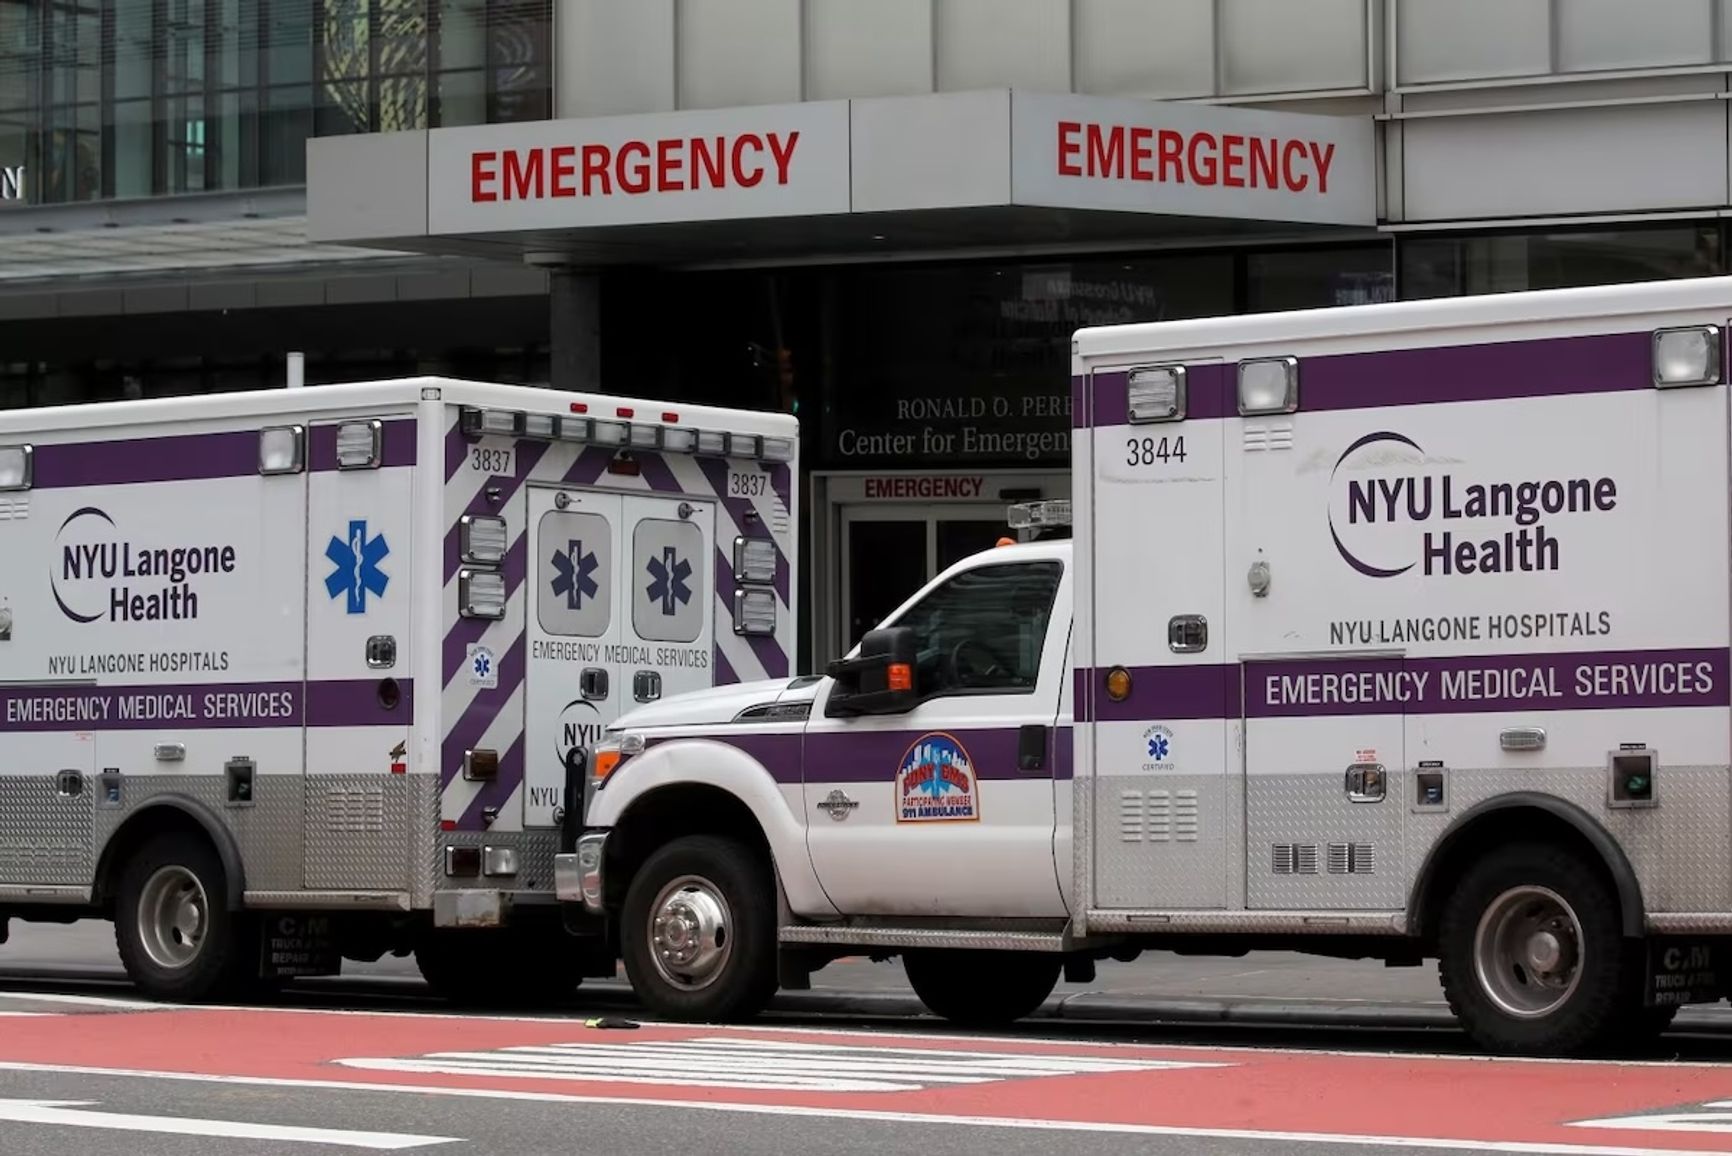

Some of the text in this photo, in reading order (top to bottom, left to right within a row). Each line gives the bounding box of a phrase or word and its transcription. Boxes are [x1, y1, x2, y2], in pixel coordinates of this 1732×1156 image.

[471, 132, 799, 202] EMERGENCY
[1058, 122, 1335, 194] EMERGENCY
[898, 397, 985, 419] RONALD
[992, 397, 1013, 418] O.
[839, 427, 1071, 459] Center for Emergen
[1127, 435, 1187, 467] 3844
[472, 448, 511, 473] 3837
[731, 472, 767, 496] 3837
[864, 477, 983, 498] EMERGENCY
[1348, 476, 1617, 525] NYU Langone
[63, 542, 235, 582] NYU Langone
[1424, 526, 1560, 576] Health
[110, 584, 198, 622] Health
[1329, 612, 1612, 645] NYU LANGONE HOSPITALS
[48, 651, 229, 674] NYU LANGONE HOSPITALS
[533, 641, 708, 669] EMERGENCY MEDICAL SERVICES
[1266, 662, 1714, 705] EMERGENCY MEDICAL SERVICES
[7, 692, 293, 722] EMERGENCY MEDICAL SERVICES
[564, 723, 601, 746] NYU
[530, 787, 558, 807] NYU
[902, 806, 973, 818] 911 AMBULANCE
